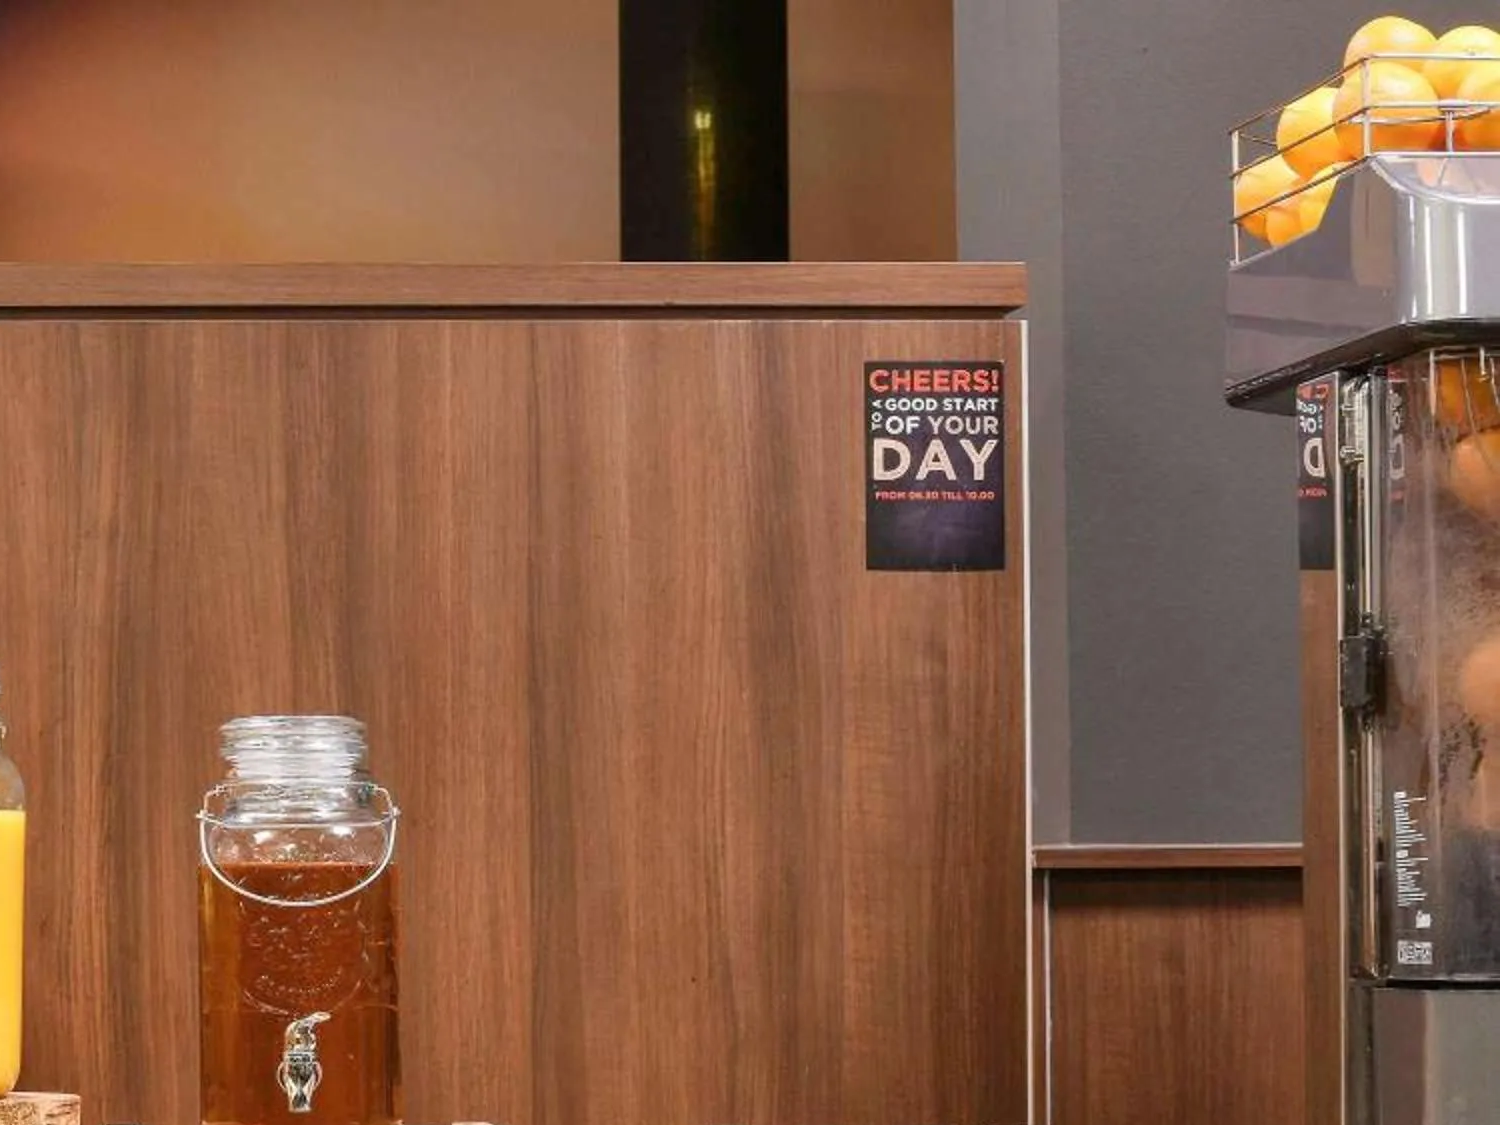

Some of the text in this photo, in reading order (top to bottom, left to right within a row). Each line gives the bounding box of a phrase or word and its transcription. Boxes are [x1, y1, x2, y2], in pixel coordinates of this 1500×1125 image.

[869, 369, 999, 393] CHEERS!
[885, 397, 999, 411] GOOD START
[885, 415, 999, 435] OF YOUR
[873, 438, 999, 481] DAY
